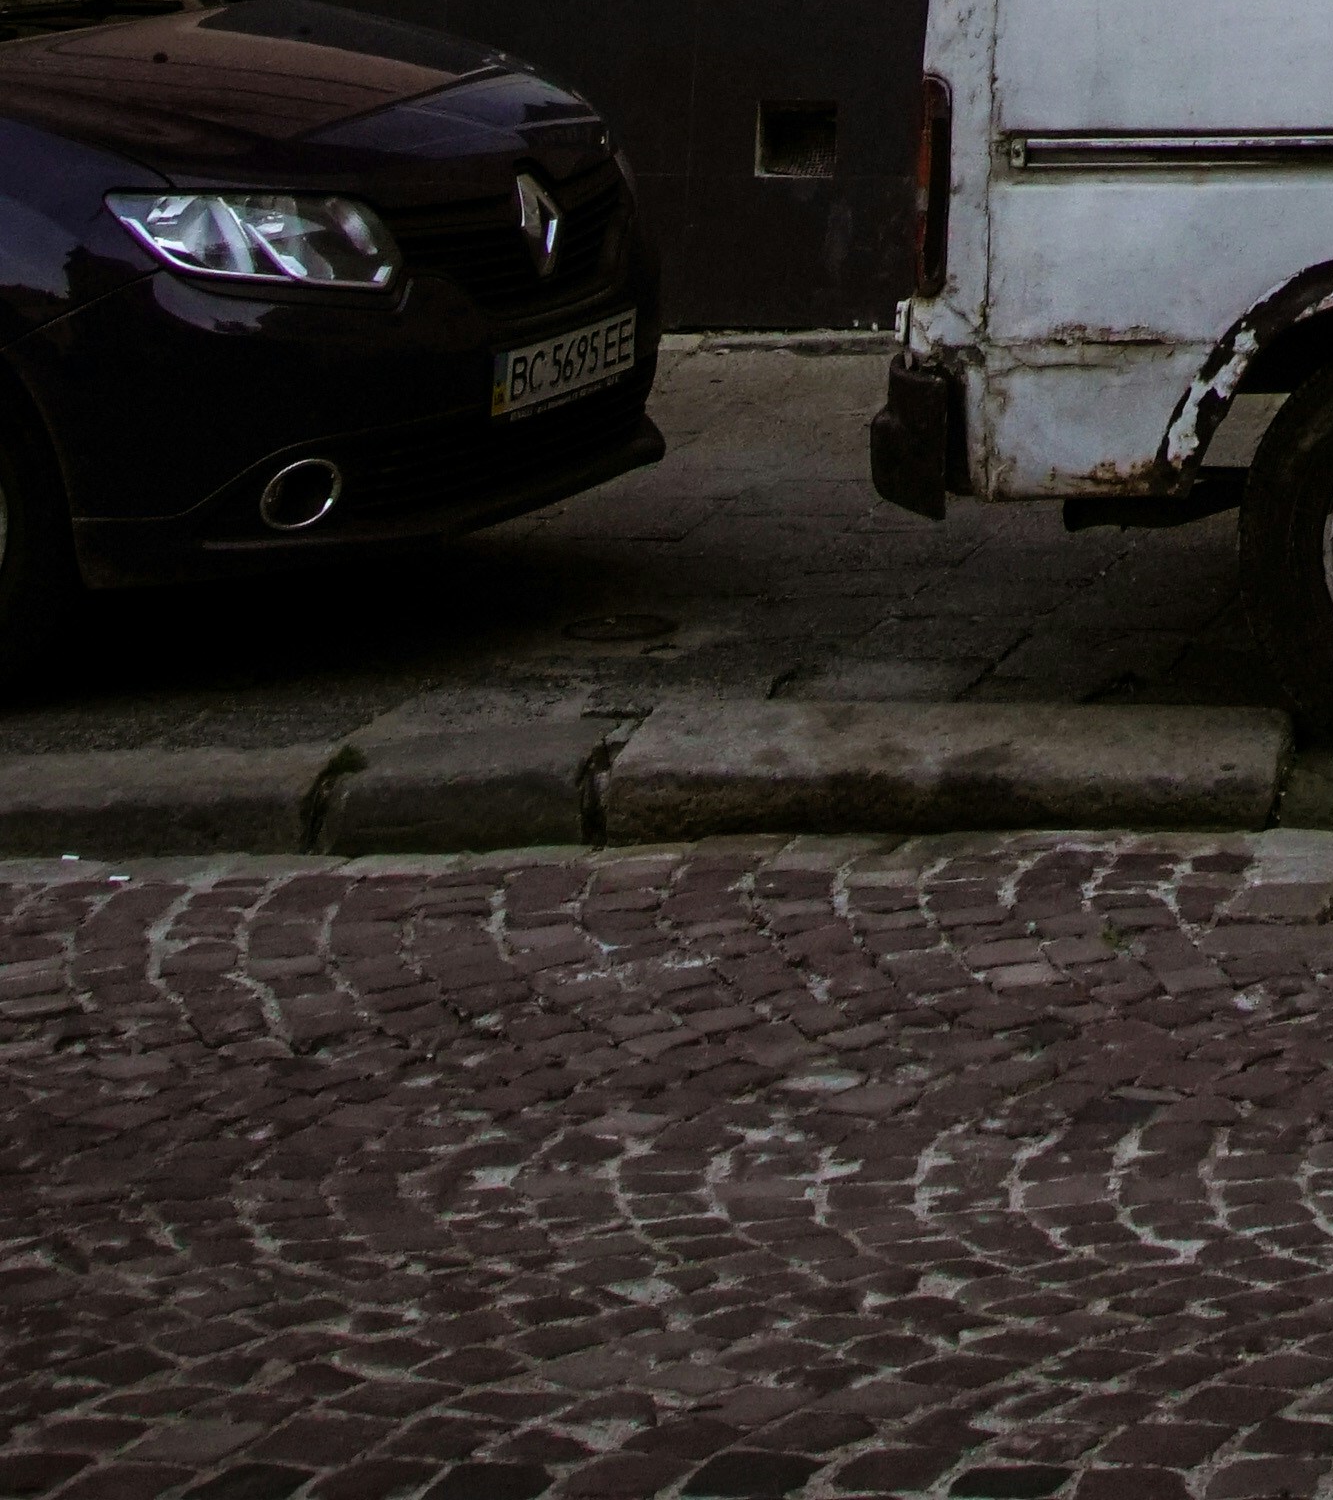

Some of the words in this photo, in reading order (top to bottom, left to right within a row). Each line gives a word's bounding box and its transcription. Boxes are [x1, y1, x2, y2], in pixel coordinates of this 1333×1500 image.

[510, 350, 546, 401] BC
[550, 330, 600, 388] 5695
[604, 318, 634, 370] EE
